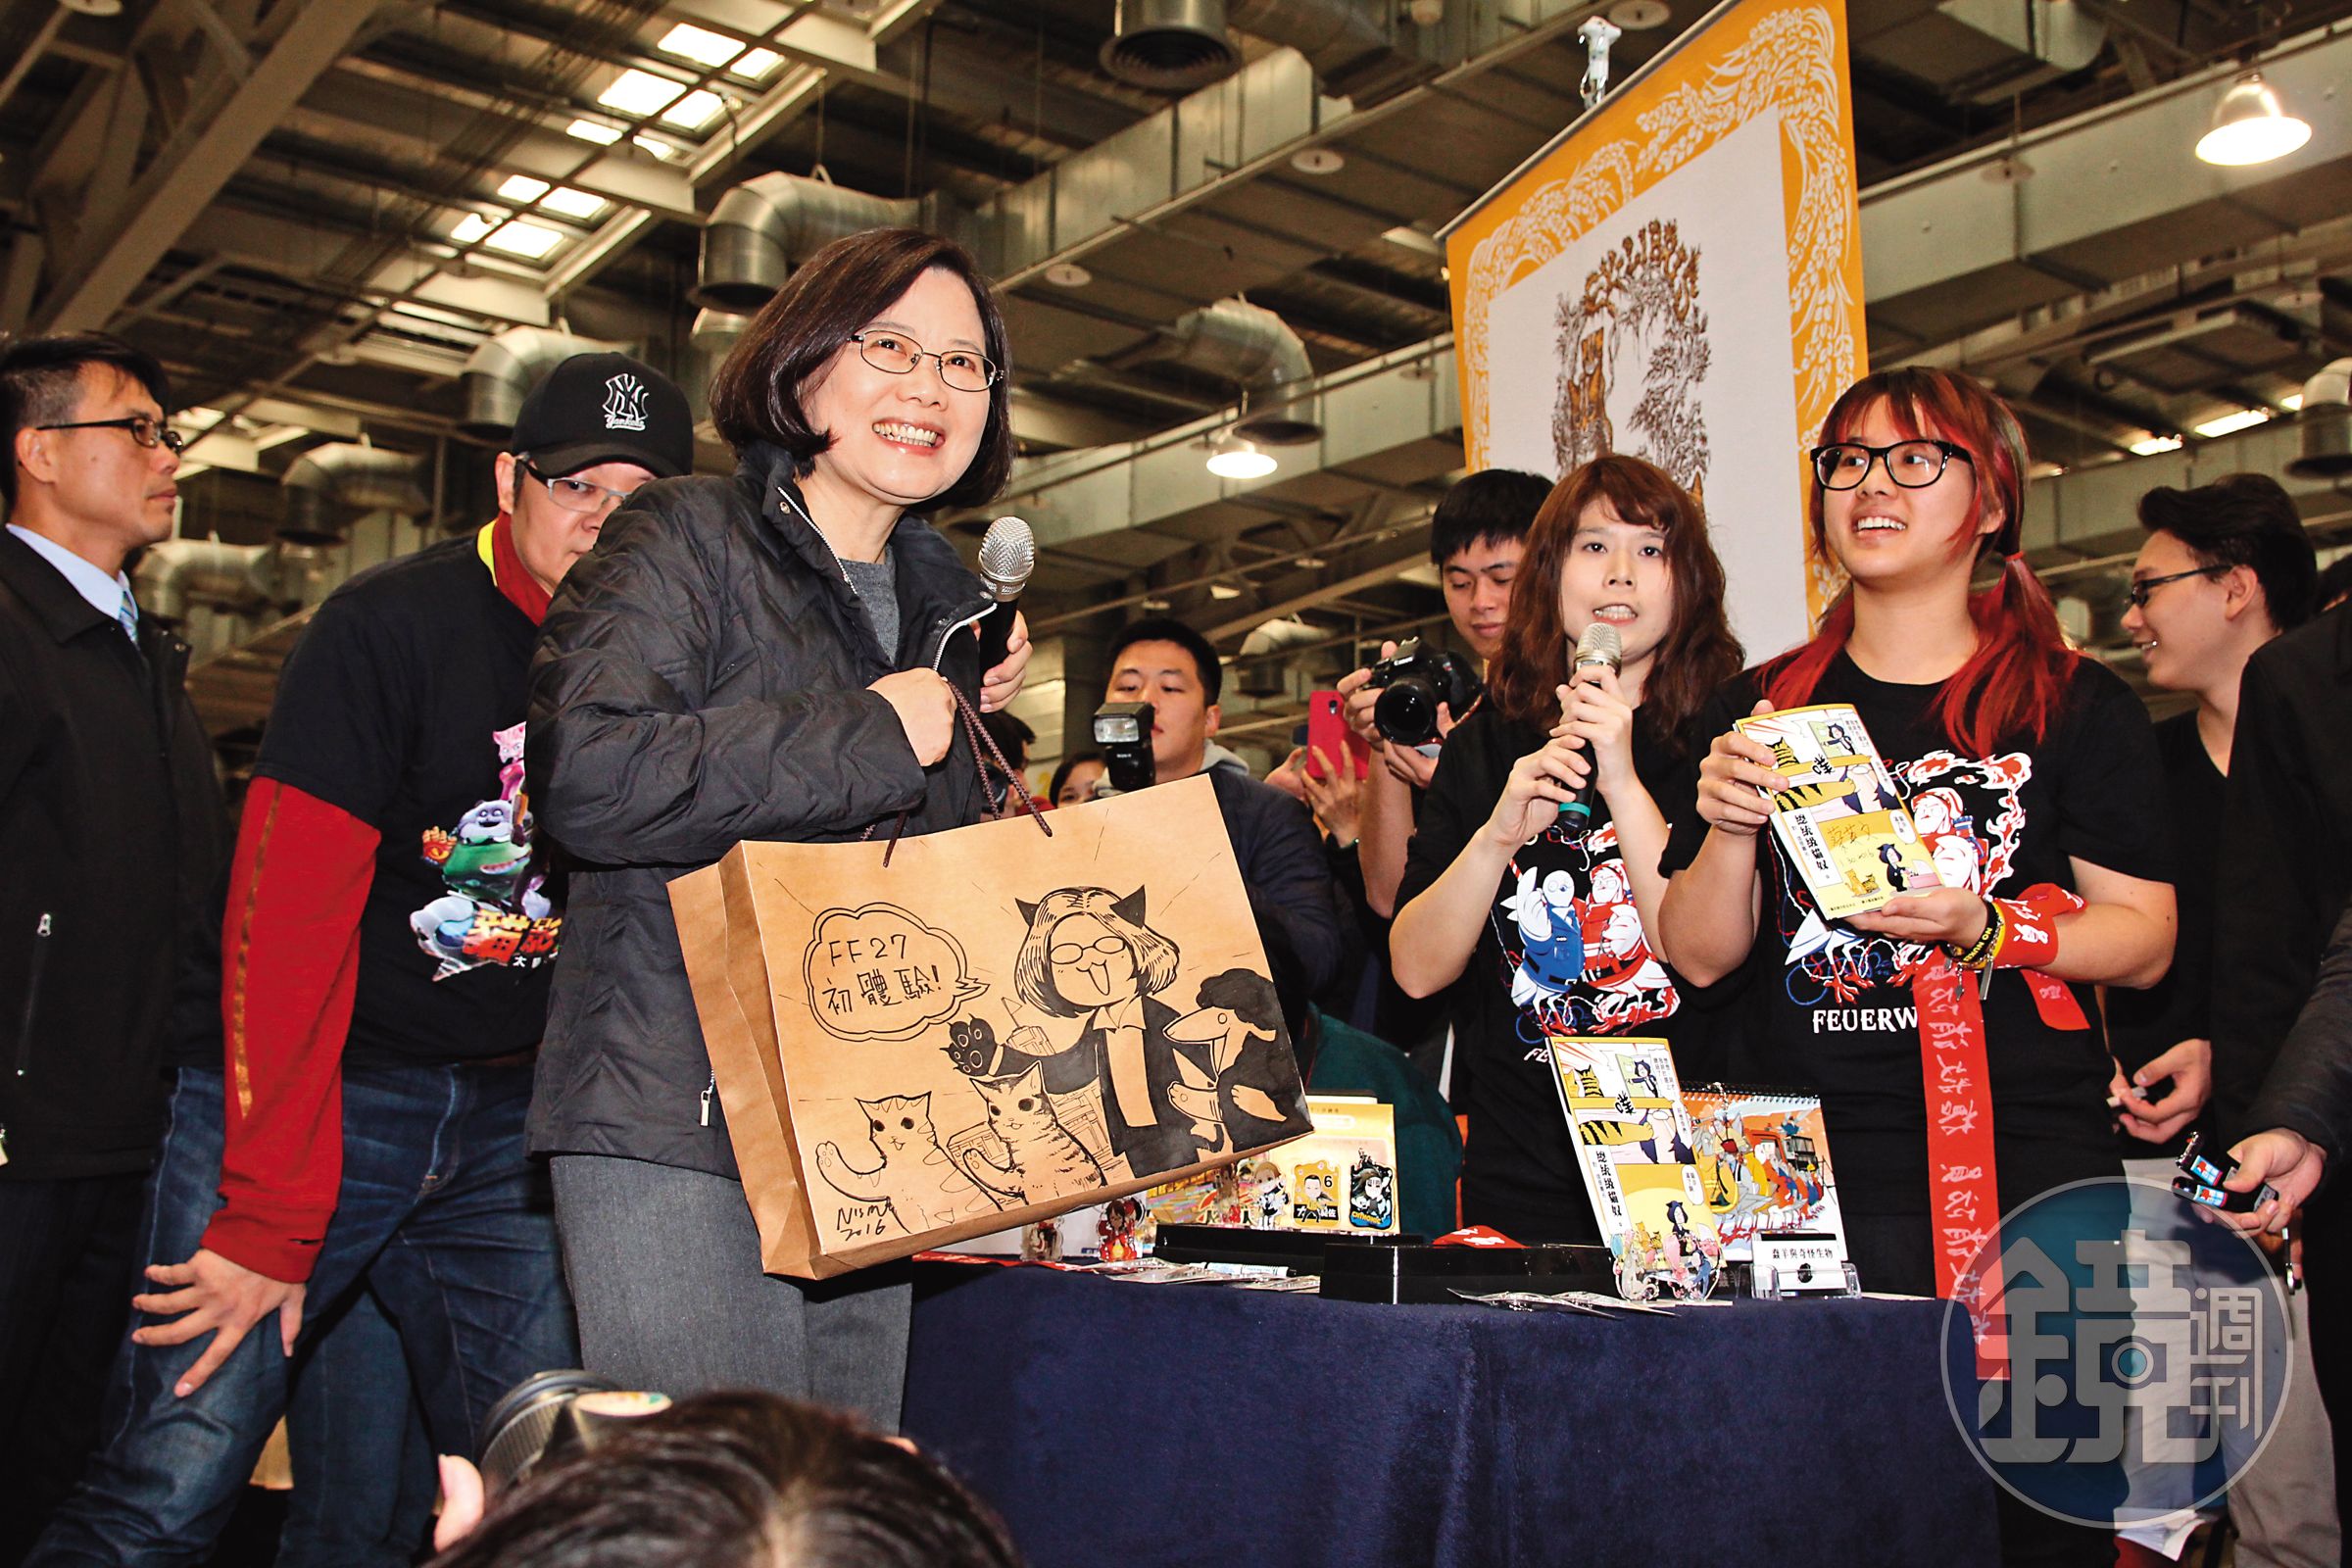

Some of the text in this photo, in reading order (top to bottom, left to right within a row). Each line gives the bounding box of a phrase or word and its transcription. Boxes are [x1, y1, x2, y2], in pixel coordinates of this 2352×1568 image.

[602, 373, 650, 421] NY
[1323, 1178, 1333, 1188] 6
[840, 1218, 887, 1242] 2016
